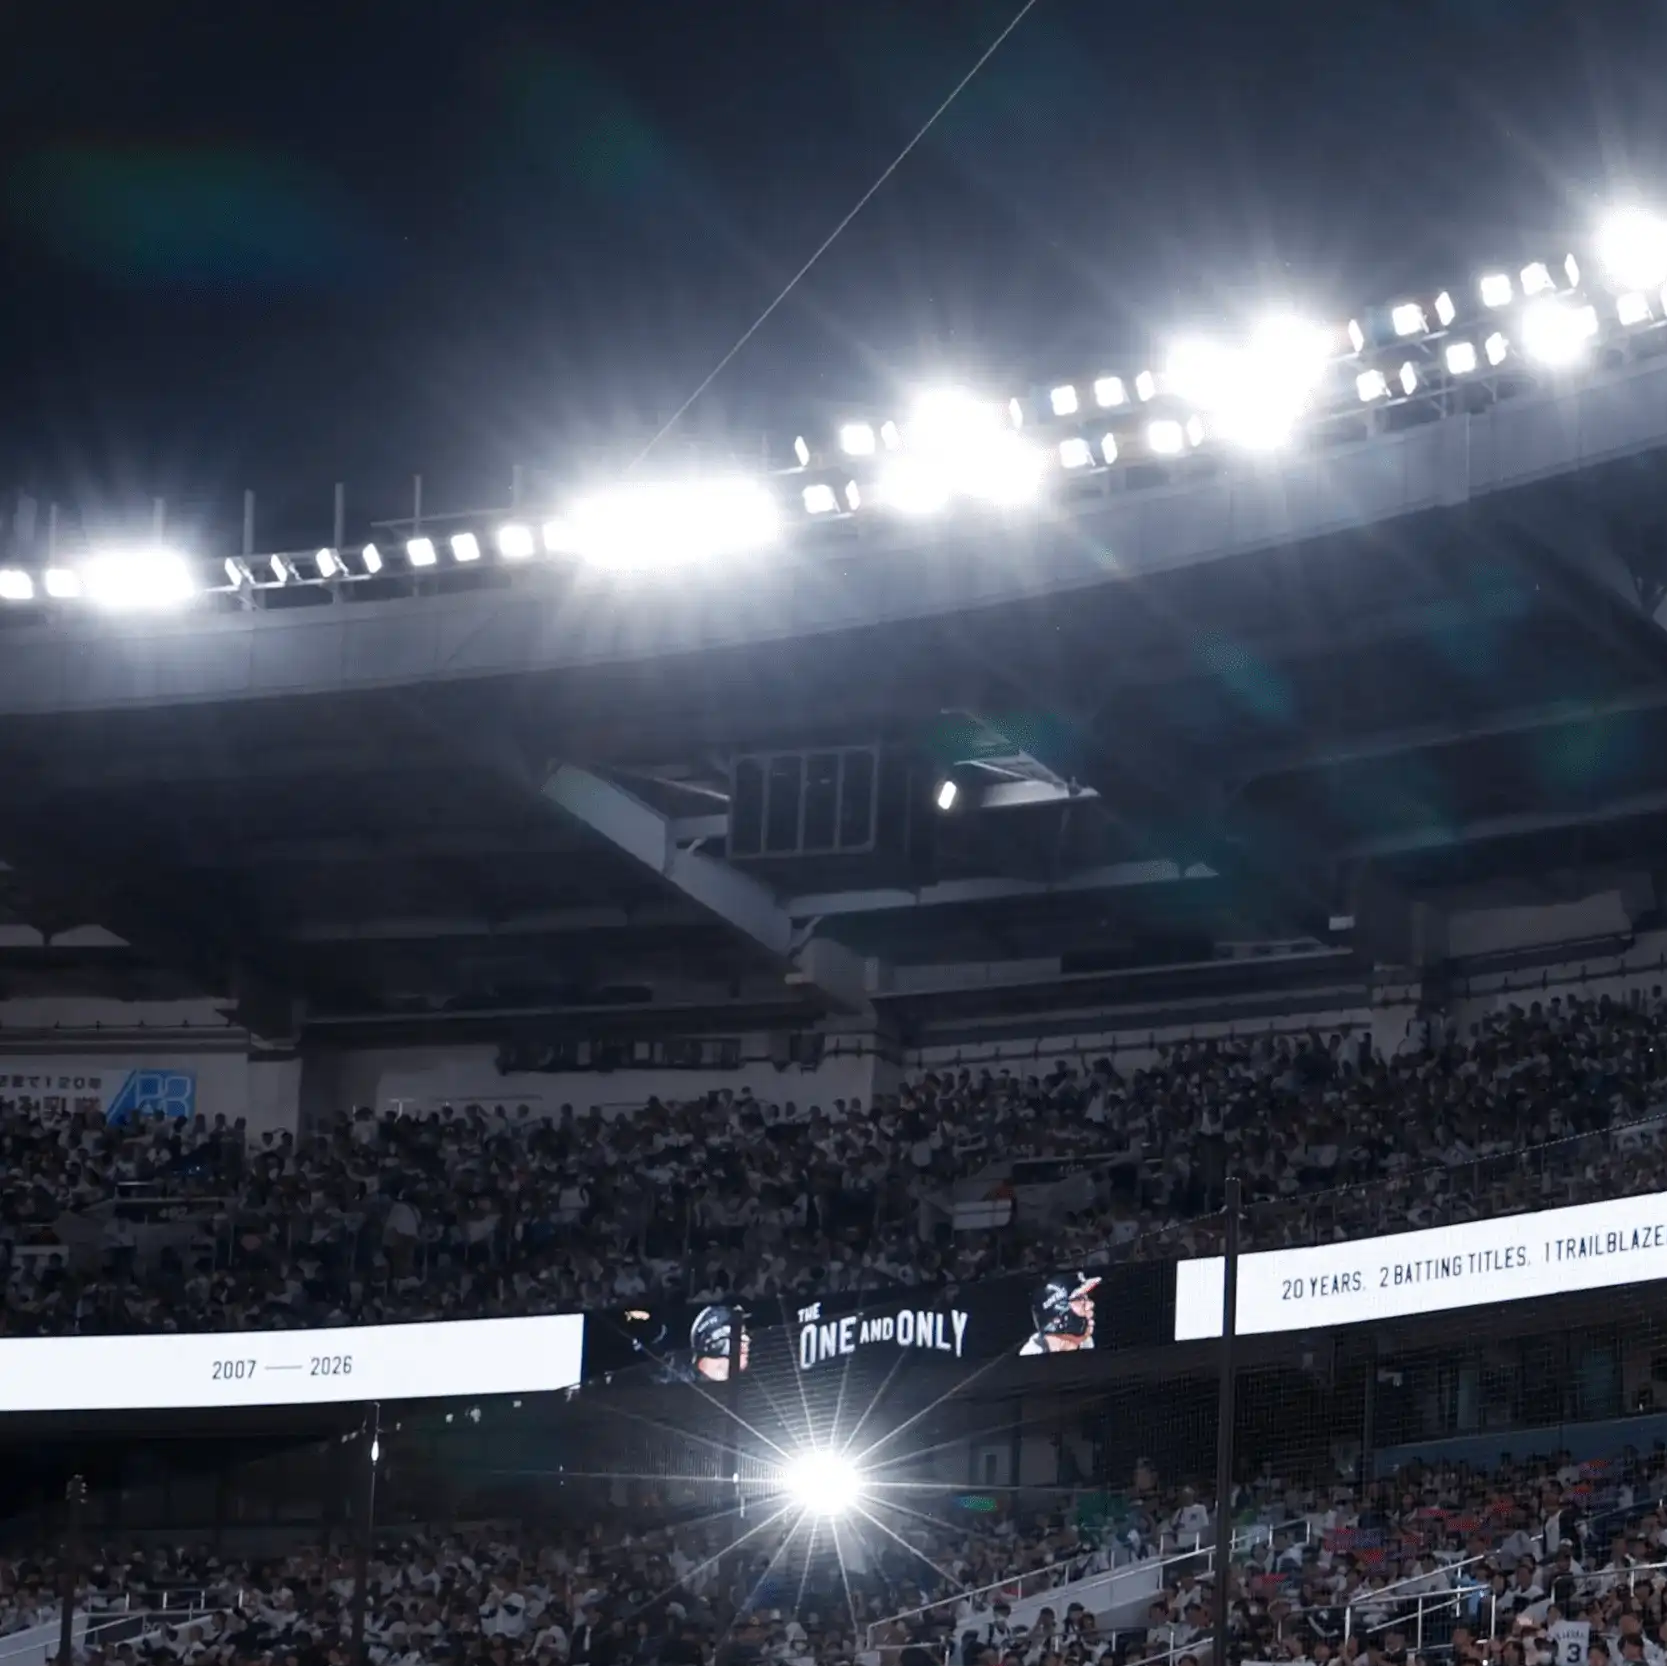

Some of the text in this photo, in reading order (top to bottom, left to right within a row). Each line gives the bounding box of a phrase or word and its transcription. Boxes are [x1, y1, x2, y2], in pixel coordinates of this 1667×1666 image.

[1282, 1279, 1304, 1301] 20
[1378, 1268, 1389, 1288] 2
[1394, 1256, 1462, 1285] BATTING
[798, 1302, 821, 1324] THE
[800, 1308, 968, 1370] ONE AND ONLY
[212, 1353, 353, 1381] 2007 2026
